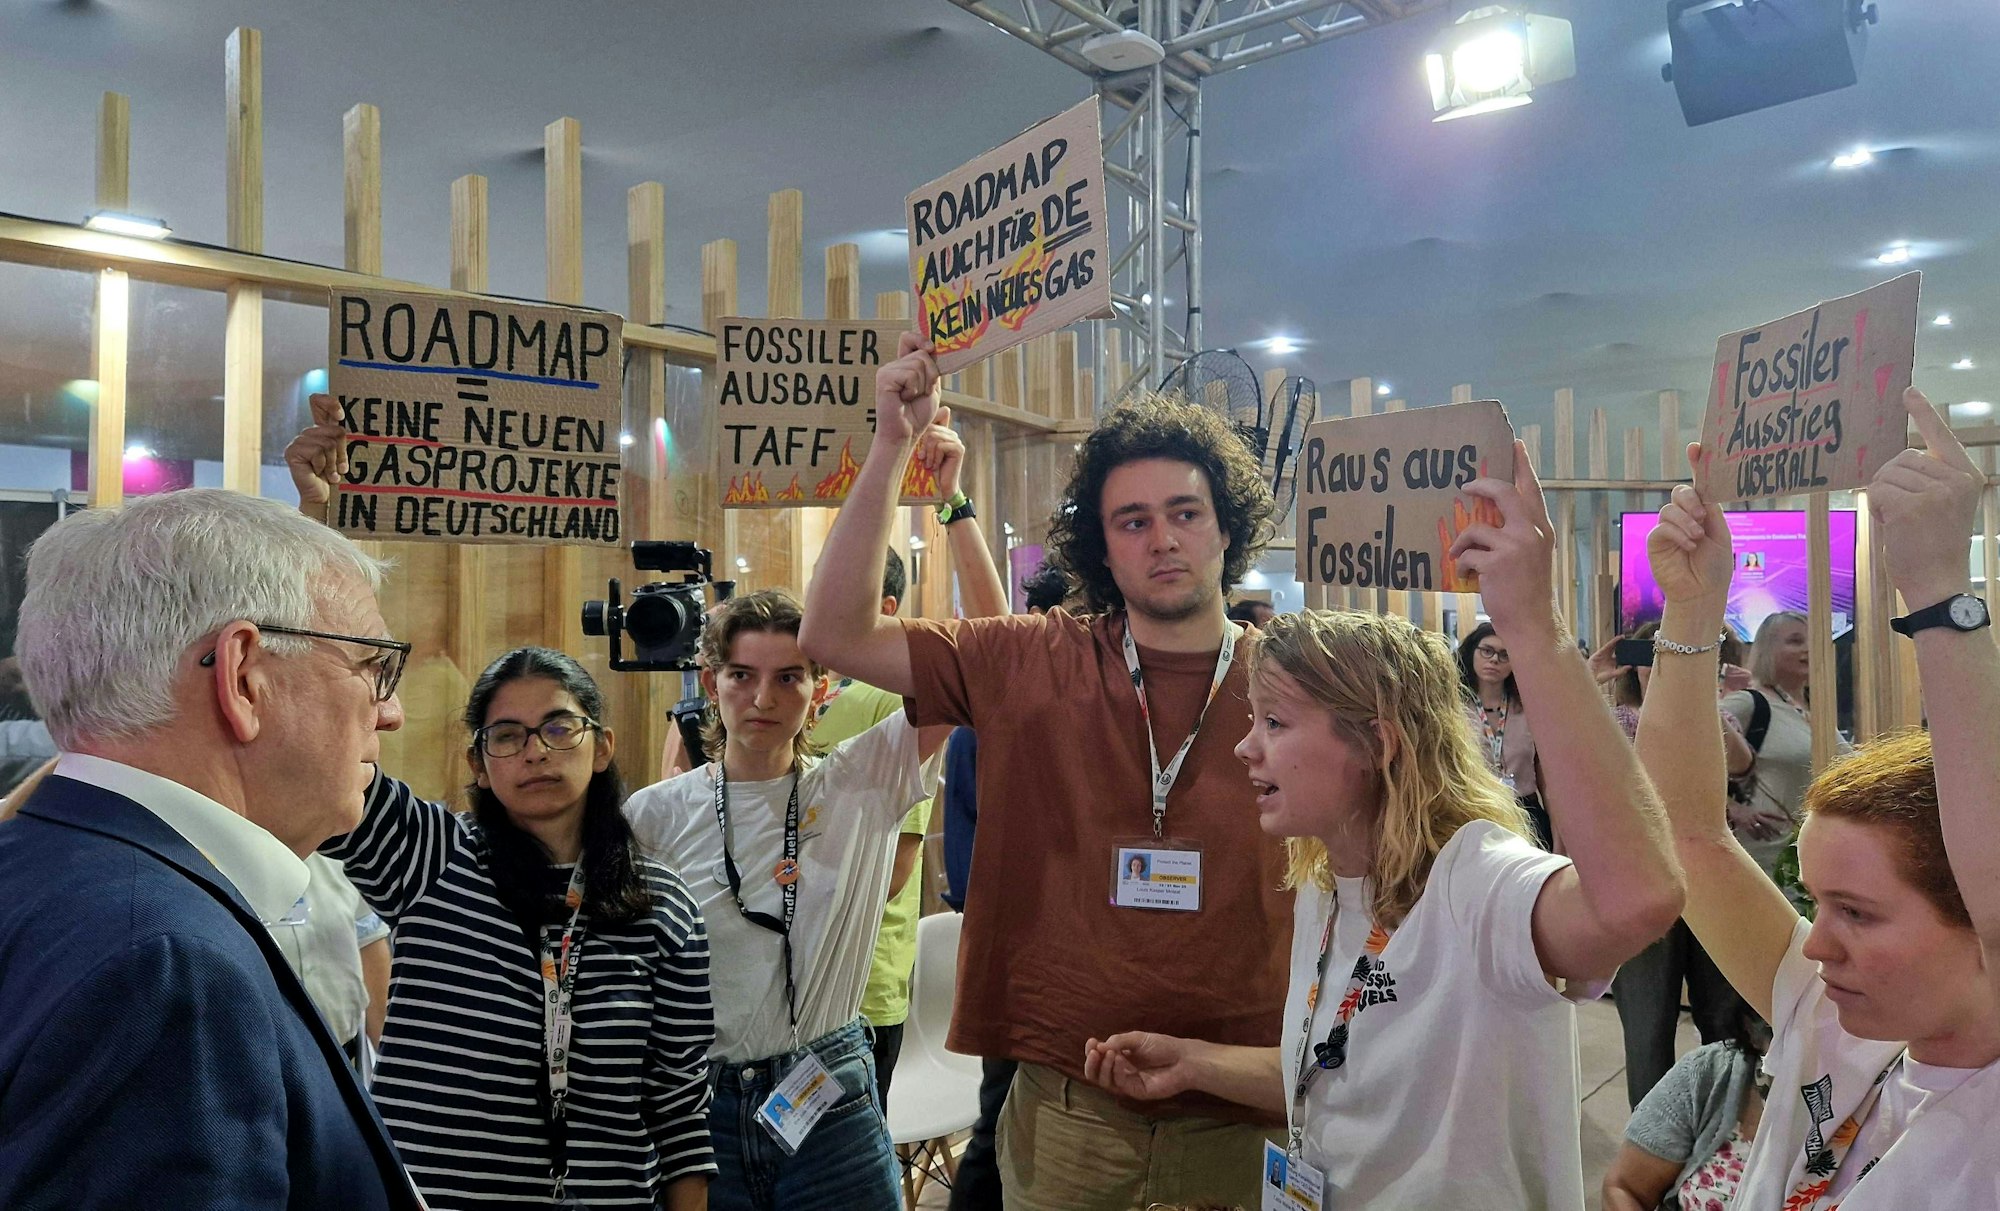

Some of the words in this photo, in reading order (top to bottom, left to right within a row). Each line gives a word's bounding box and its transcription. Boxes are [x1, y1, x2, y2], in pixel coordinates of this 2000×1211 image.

[913, 138, 1068, 247] ROADMAP
[920, 225, 994, 296] AUCH
[998, 207, 1036, 260] FÜR
[1042, 178, 1090, 237] DE
[930, 289, 983, 342] KEIN
[1045, 249, 1096, 301] GAS
[340, 296, 609, 380] ROADMAP
[724, 325, 879, 365] FOSSILER
[1734, 309, 1849, 408] Fossiler
[720, 371, 859, 406] AUSBAU
[338, 395, 443, 442] KEINE
[464, 406, 605, 453] NEUEN
[724, 425, 836, 467] TAFF
[1727, 389, 1843, 456] Ausstieg
[345, 440, 621, 500] GASPROJEKTE
[1307, 437, 1391, 494] Raus
[1403, 445, 1477, 491] aus
[338, 493, 377, 532] IN
[395, 496, 619, 543] DEUTSCHLAND
[1307, 505, 1432, 590] Fossilen
[1357, 988, 1398, 1013] UELS
